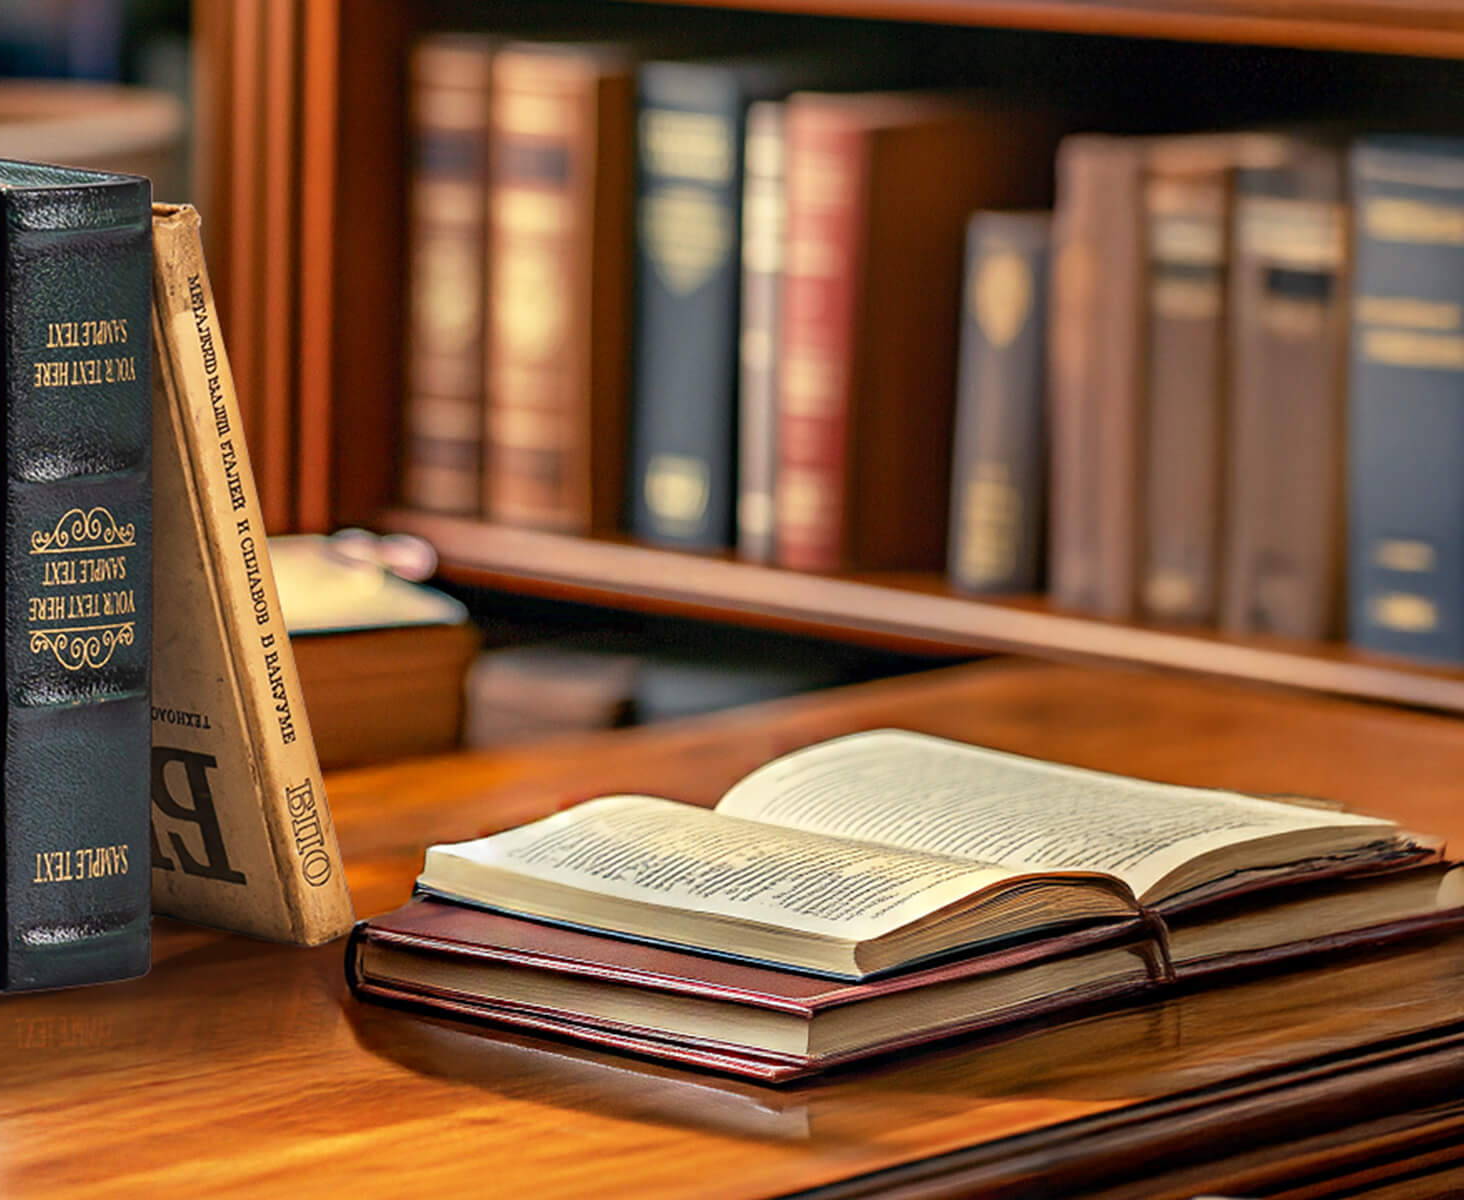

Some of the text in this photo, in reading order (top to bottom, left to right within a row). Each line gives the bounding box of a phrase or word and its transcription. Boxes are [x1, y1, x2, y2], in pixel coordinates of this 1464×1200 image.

[46, 319, 128, 348] SAMPLE TEXT
[33, 356, 136, 388] YOUR TEXT HERE
[42, 555, 126, 587] SAMPLE TEXT
[240, 537, 270, 625] СПЛАВОВ
[28, 589, 136, 622] YOUR TEXT HERE
[261, 633, 275, 648] В
[264, 650, 296, 745] ВАКУУМЕ
[33, 844, 129, 884] SAMPLE TEXT
